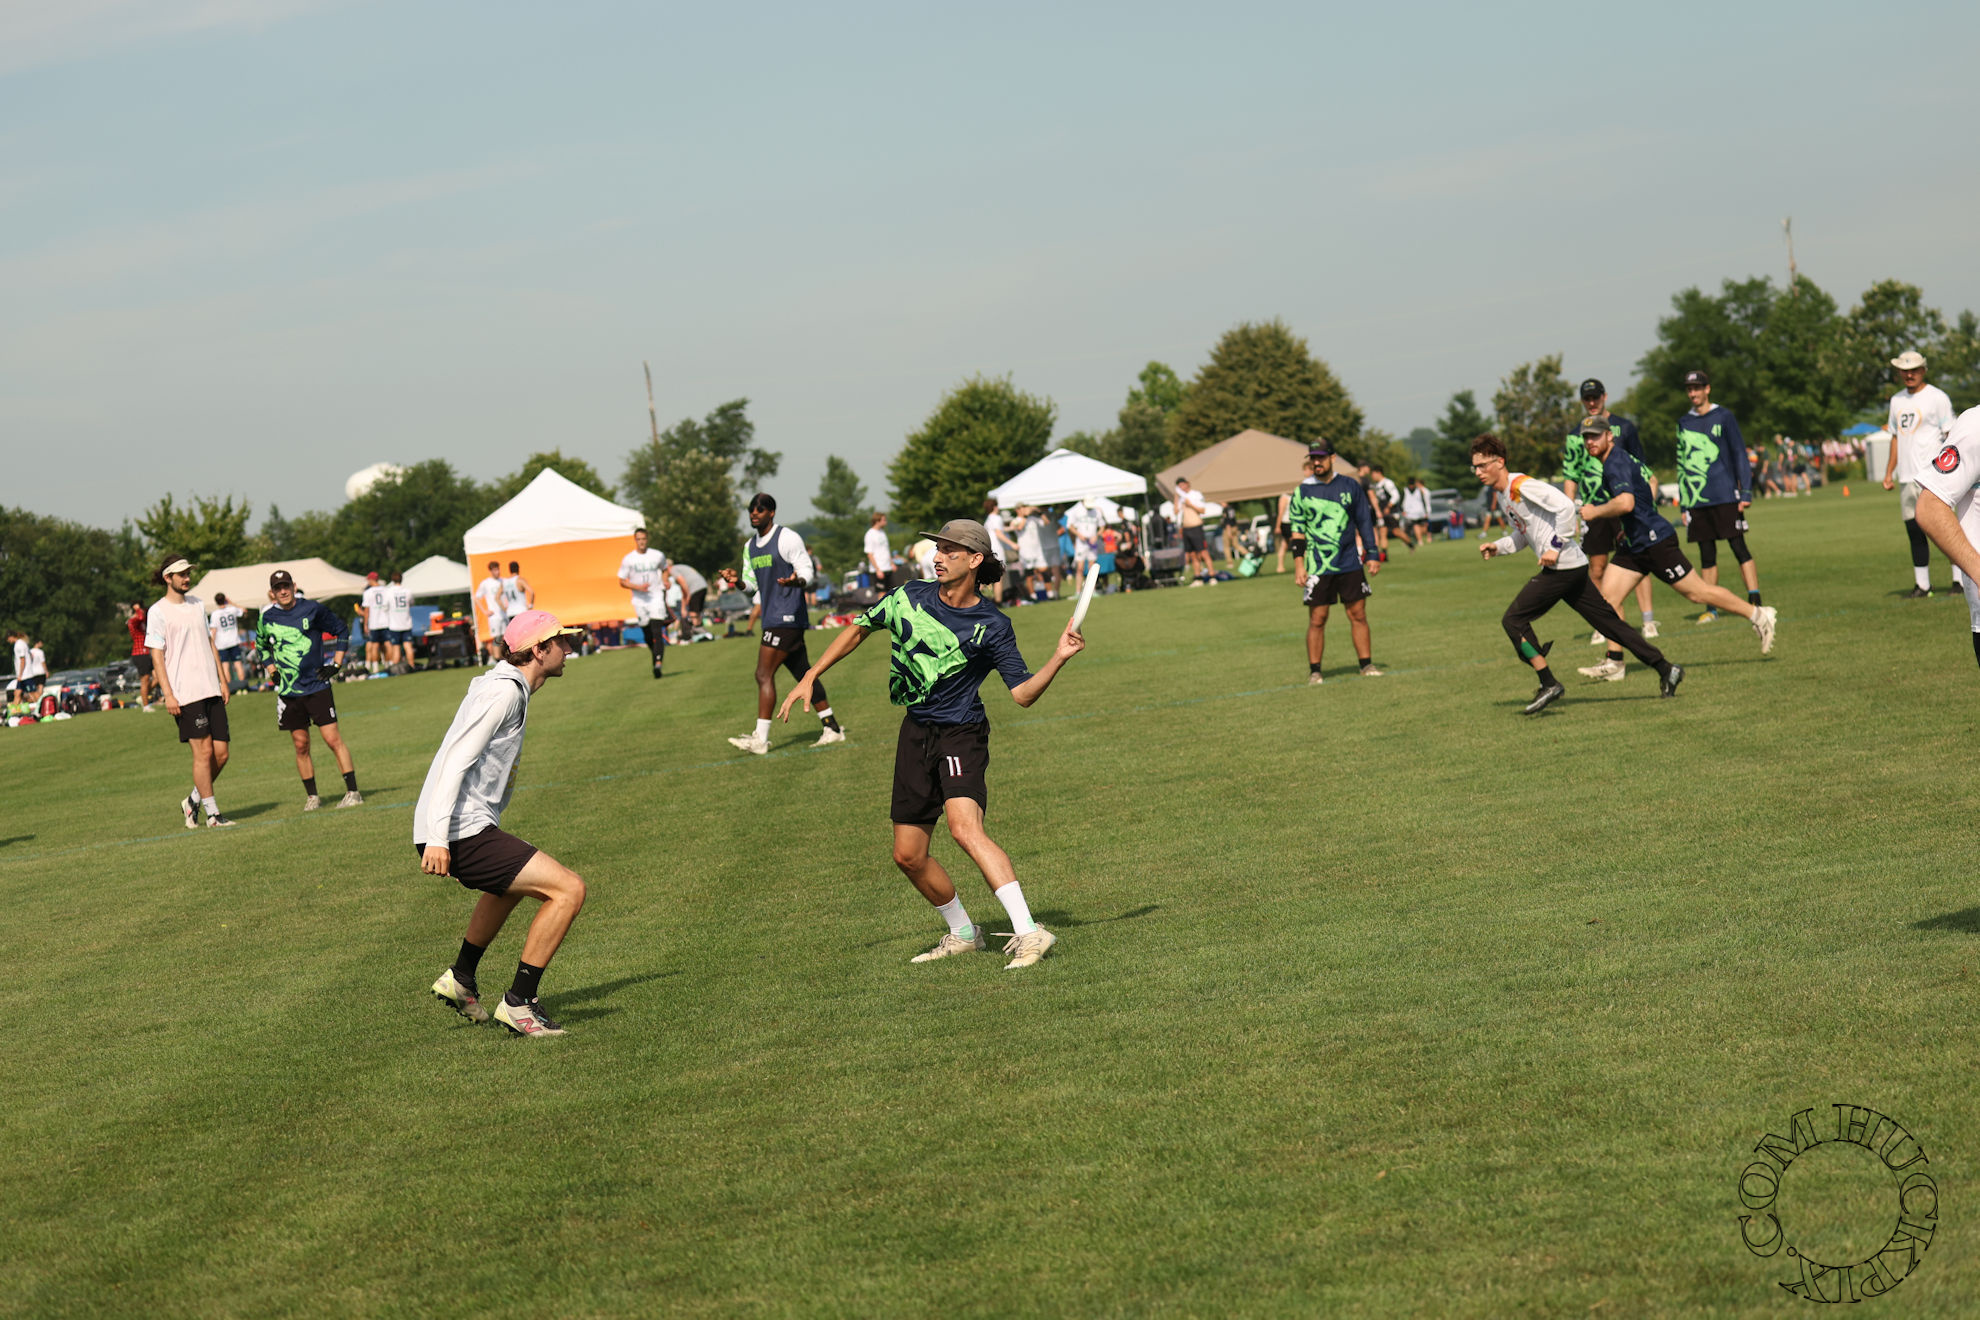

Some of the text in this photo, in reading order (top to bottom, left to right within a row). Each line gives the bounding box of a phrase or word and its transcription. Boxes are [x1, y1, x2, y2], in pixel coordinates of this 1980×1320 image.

[1901, 413, 1915, 428] 27
[1711, 424, 1722, 437] 41
[375, 593, 383, 605] 0
[394, 596, 407, 608] 15
[219, 614, 235, 628] 89
[302, 617, 309, 630] 8
[763, 631, 772, 643] 21
[969, 623, 987, 645] 11
[946, 755, 963, 777] 11
